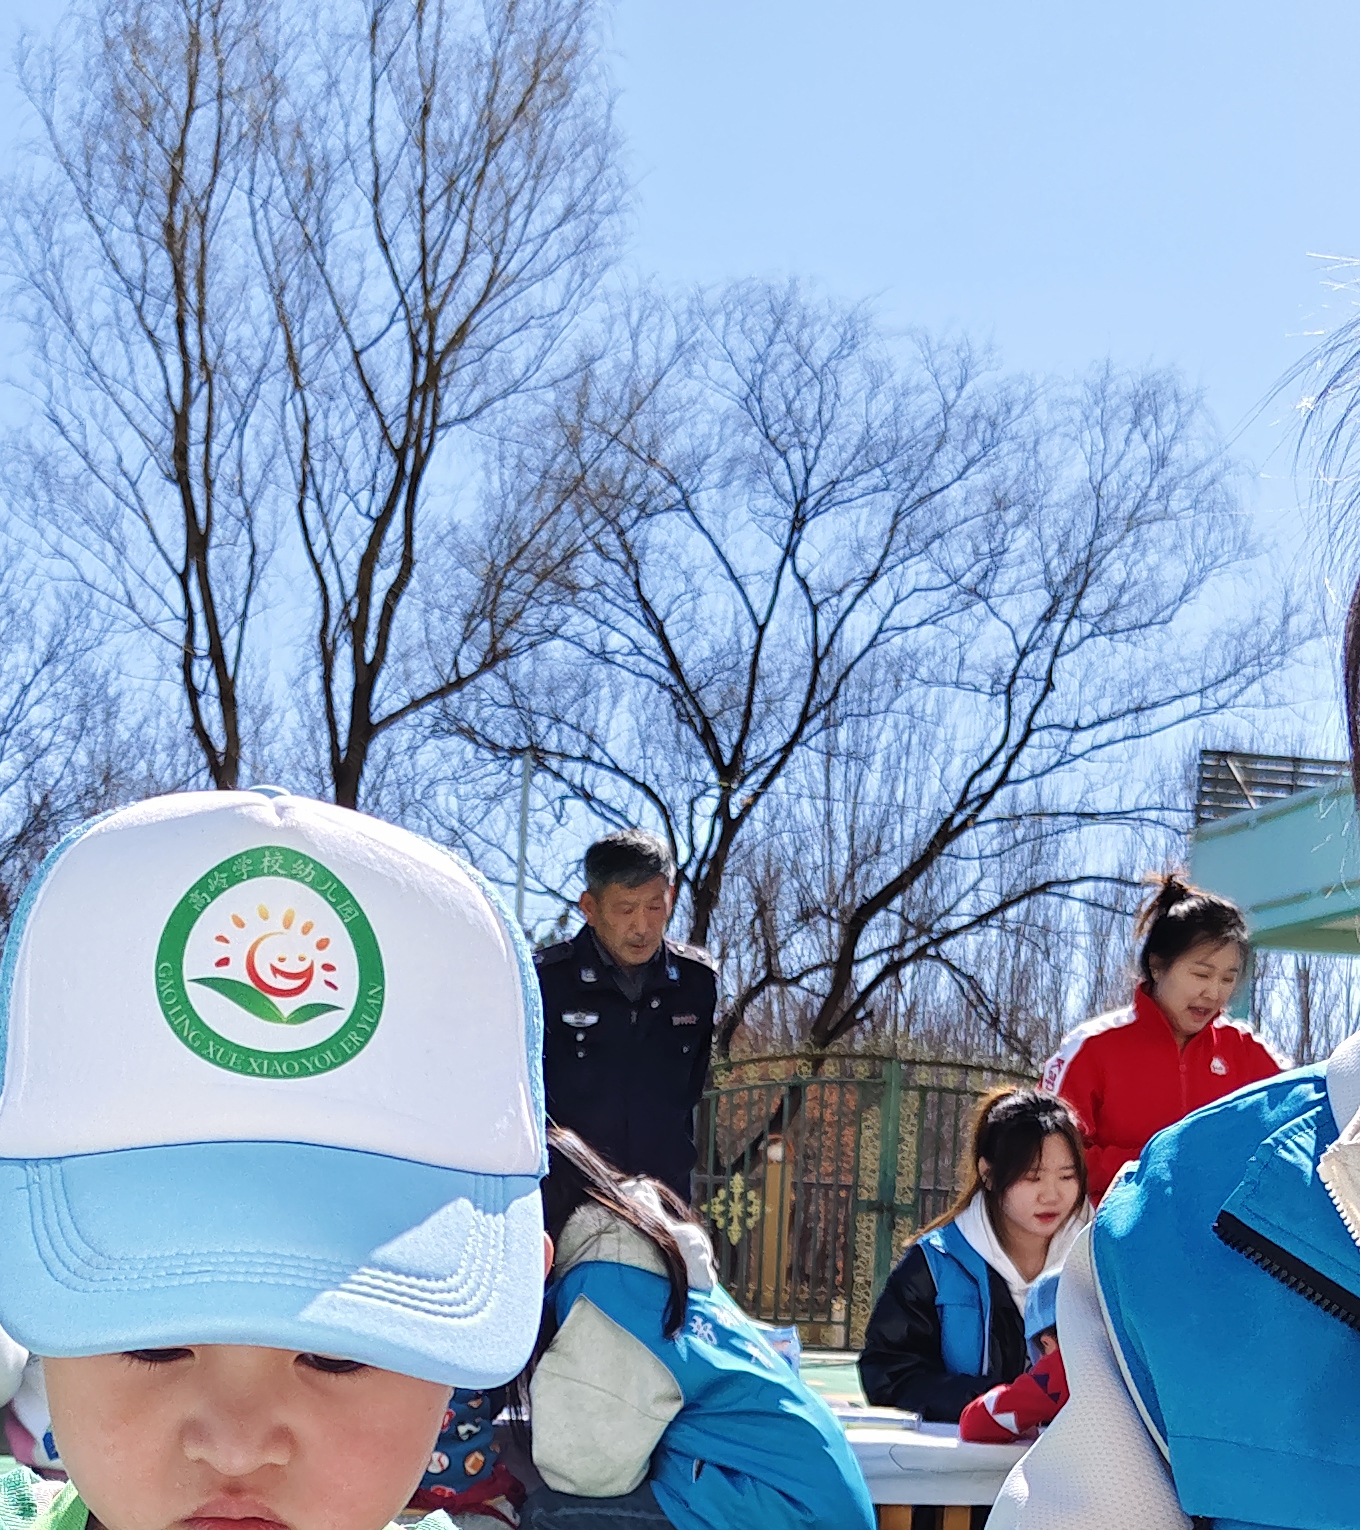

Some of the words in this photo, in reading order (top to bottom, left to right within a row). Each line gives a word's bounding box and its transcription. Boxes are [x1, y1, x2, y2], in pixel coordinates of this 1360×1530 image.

[187, 850, 359, 924] 高岭学校幼儿园
[157, 962, 179, 1008] GAO
[169, 1004, 205, 1048] LING
[206, 1040, 244, 1071] XUE
[249, 1057, 300, 1076] XIAO
[299, 1047, 342, 1072] YOU
[340, 1032, 364, 1055] ER
[357, 982, 384, 1034] YUAN
